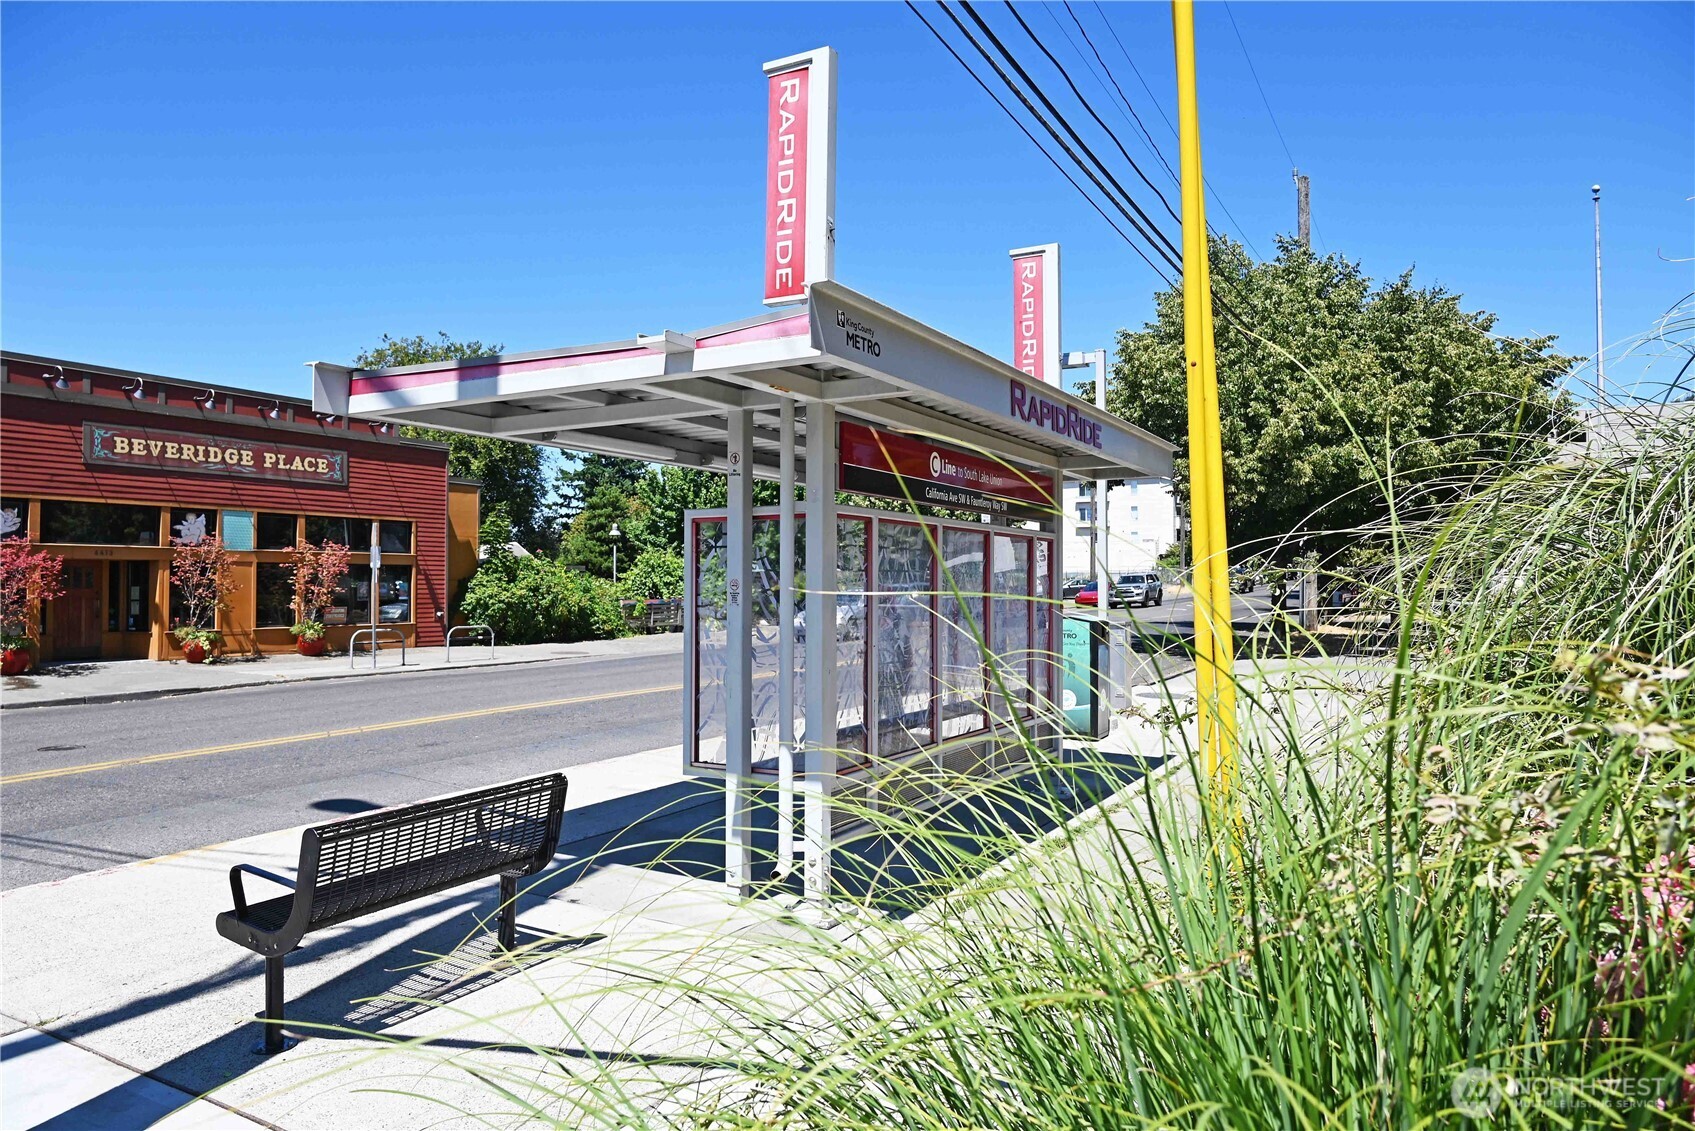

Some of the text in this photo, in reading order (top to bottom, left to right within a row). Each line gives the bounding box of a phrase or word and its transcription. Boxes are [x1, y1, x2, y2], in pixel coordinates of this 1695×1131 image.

[775, 78, 799, 290] RAPIDRIDE
[846, 317, 875, 339] King County
[1021, 261, 1037, 378] RAPIDRI
[846, 330, 881, 357] METRO
[1010, 379, 1103, 449] RAPIDRIDE
[113, 436, 330, 474] BEVERIDGE PLACE
[941, 459, 956, 477] Line
[957, 466, 963, 478] to
[964, 466, 977, 480] South
[978, 470, 989, 484] Lake
[989, 473, 1003, 487] Union
[925, 487, 949, 502] California
[949, 491, 958, 503] Ave
[958, 493, 966, 504] SW
[1063, 632, 1077, 640] TRO
